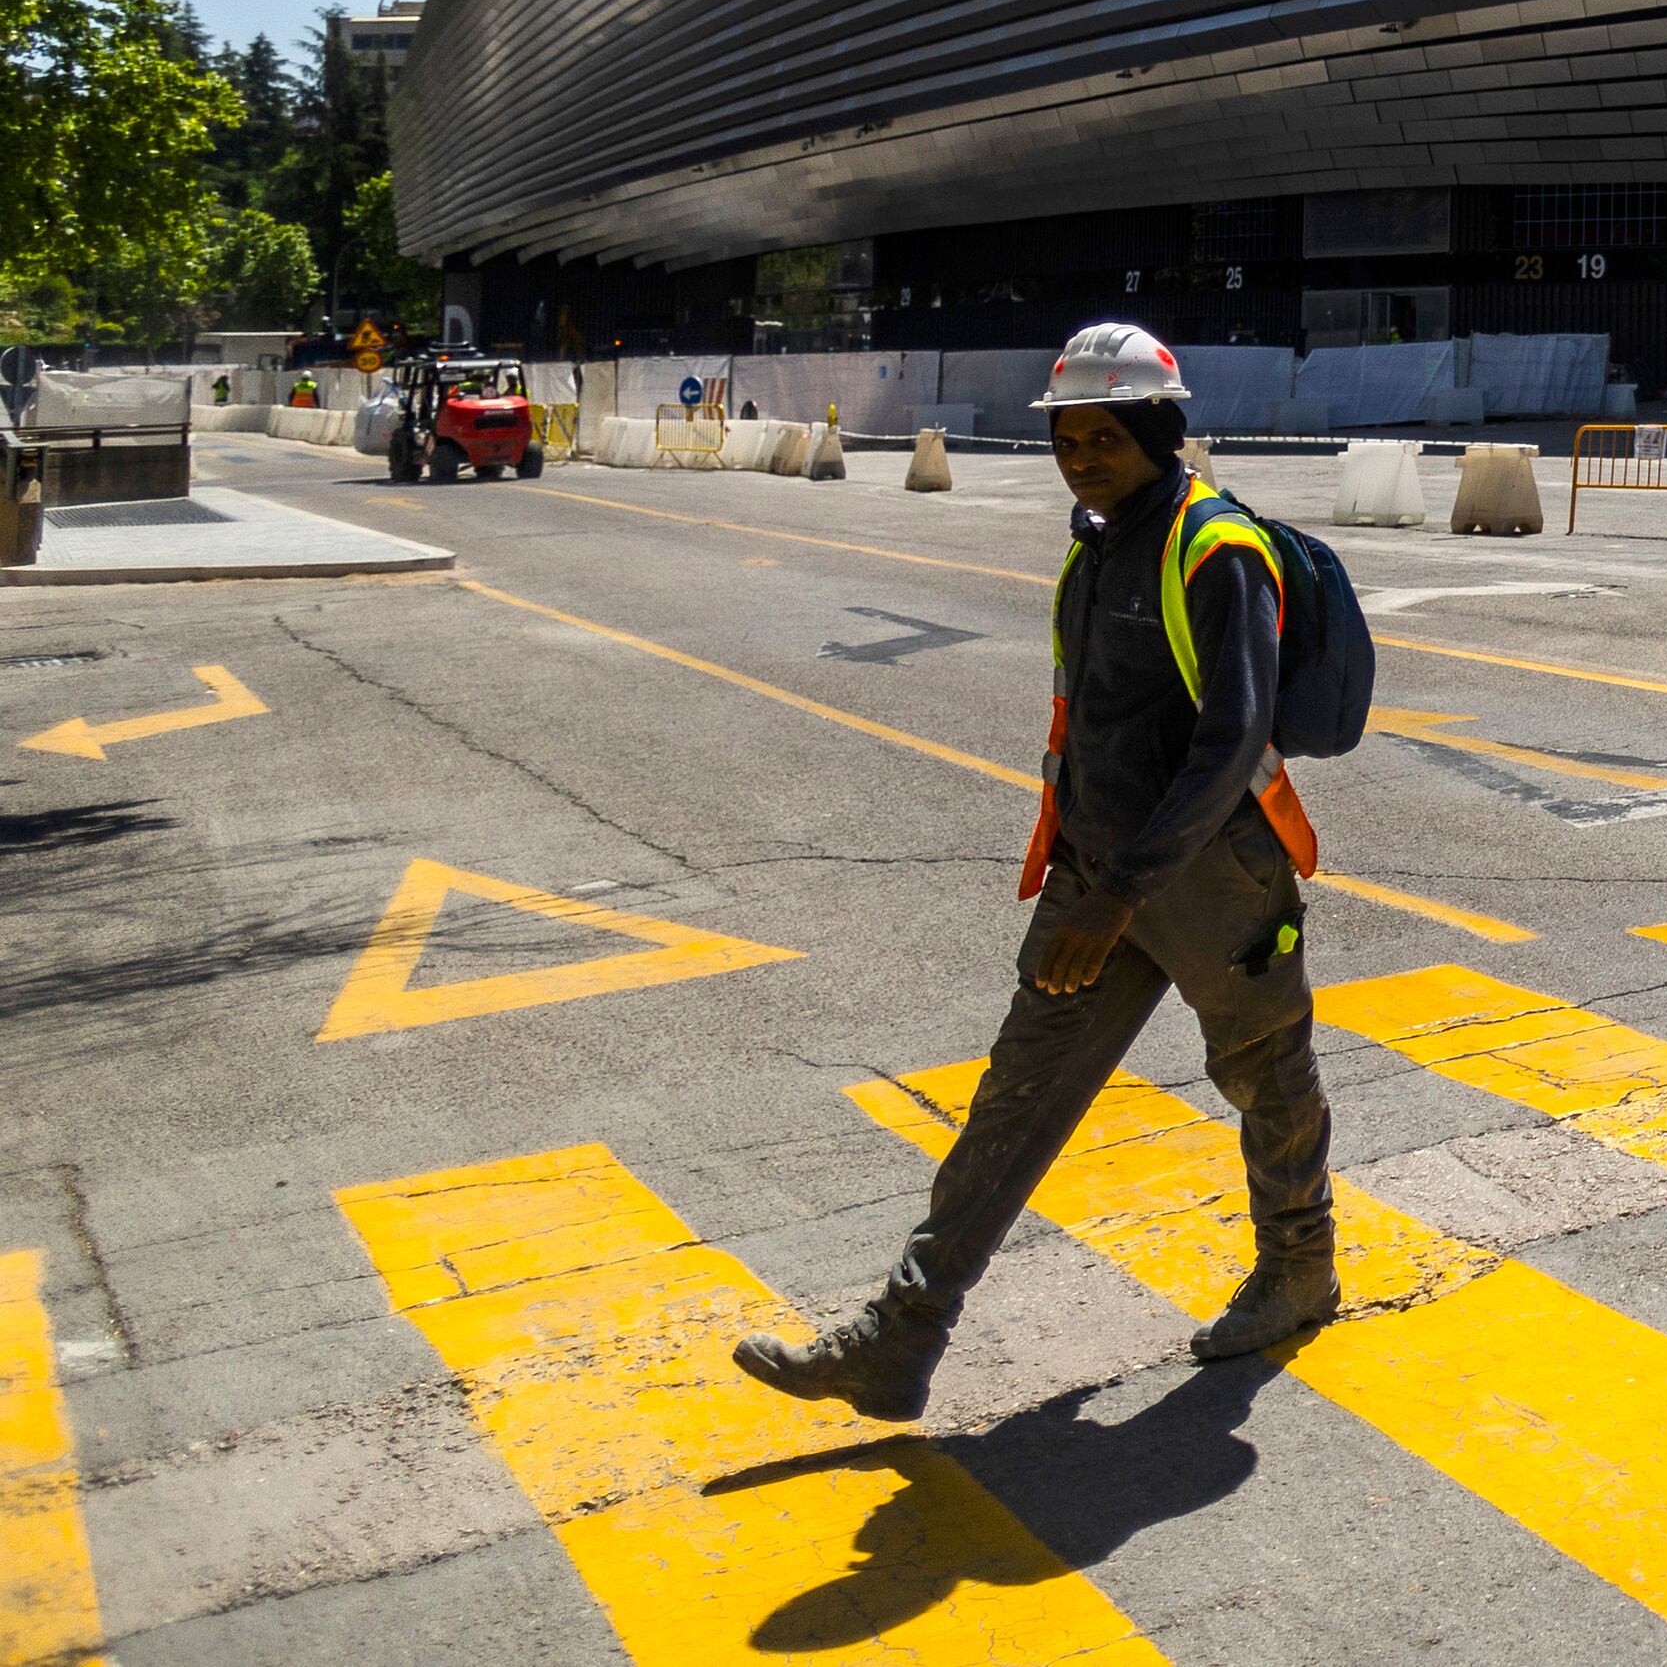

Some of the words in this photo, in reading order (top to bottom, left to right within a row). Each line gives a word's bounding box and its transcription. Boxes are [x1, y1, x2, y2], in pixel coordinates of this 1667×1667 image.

[1225, 266, 1243, 290] 25
[1514, 254, 1543, 280] 23
[1577, 253, 1606, 279] 19
[1125, 270, 1141, 293] 27
